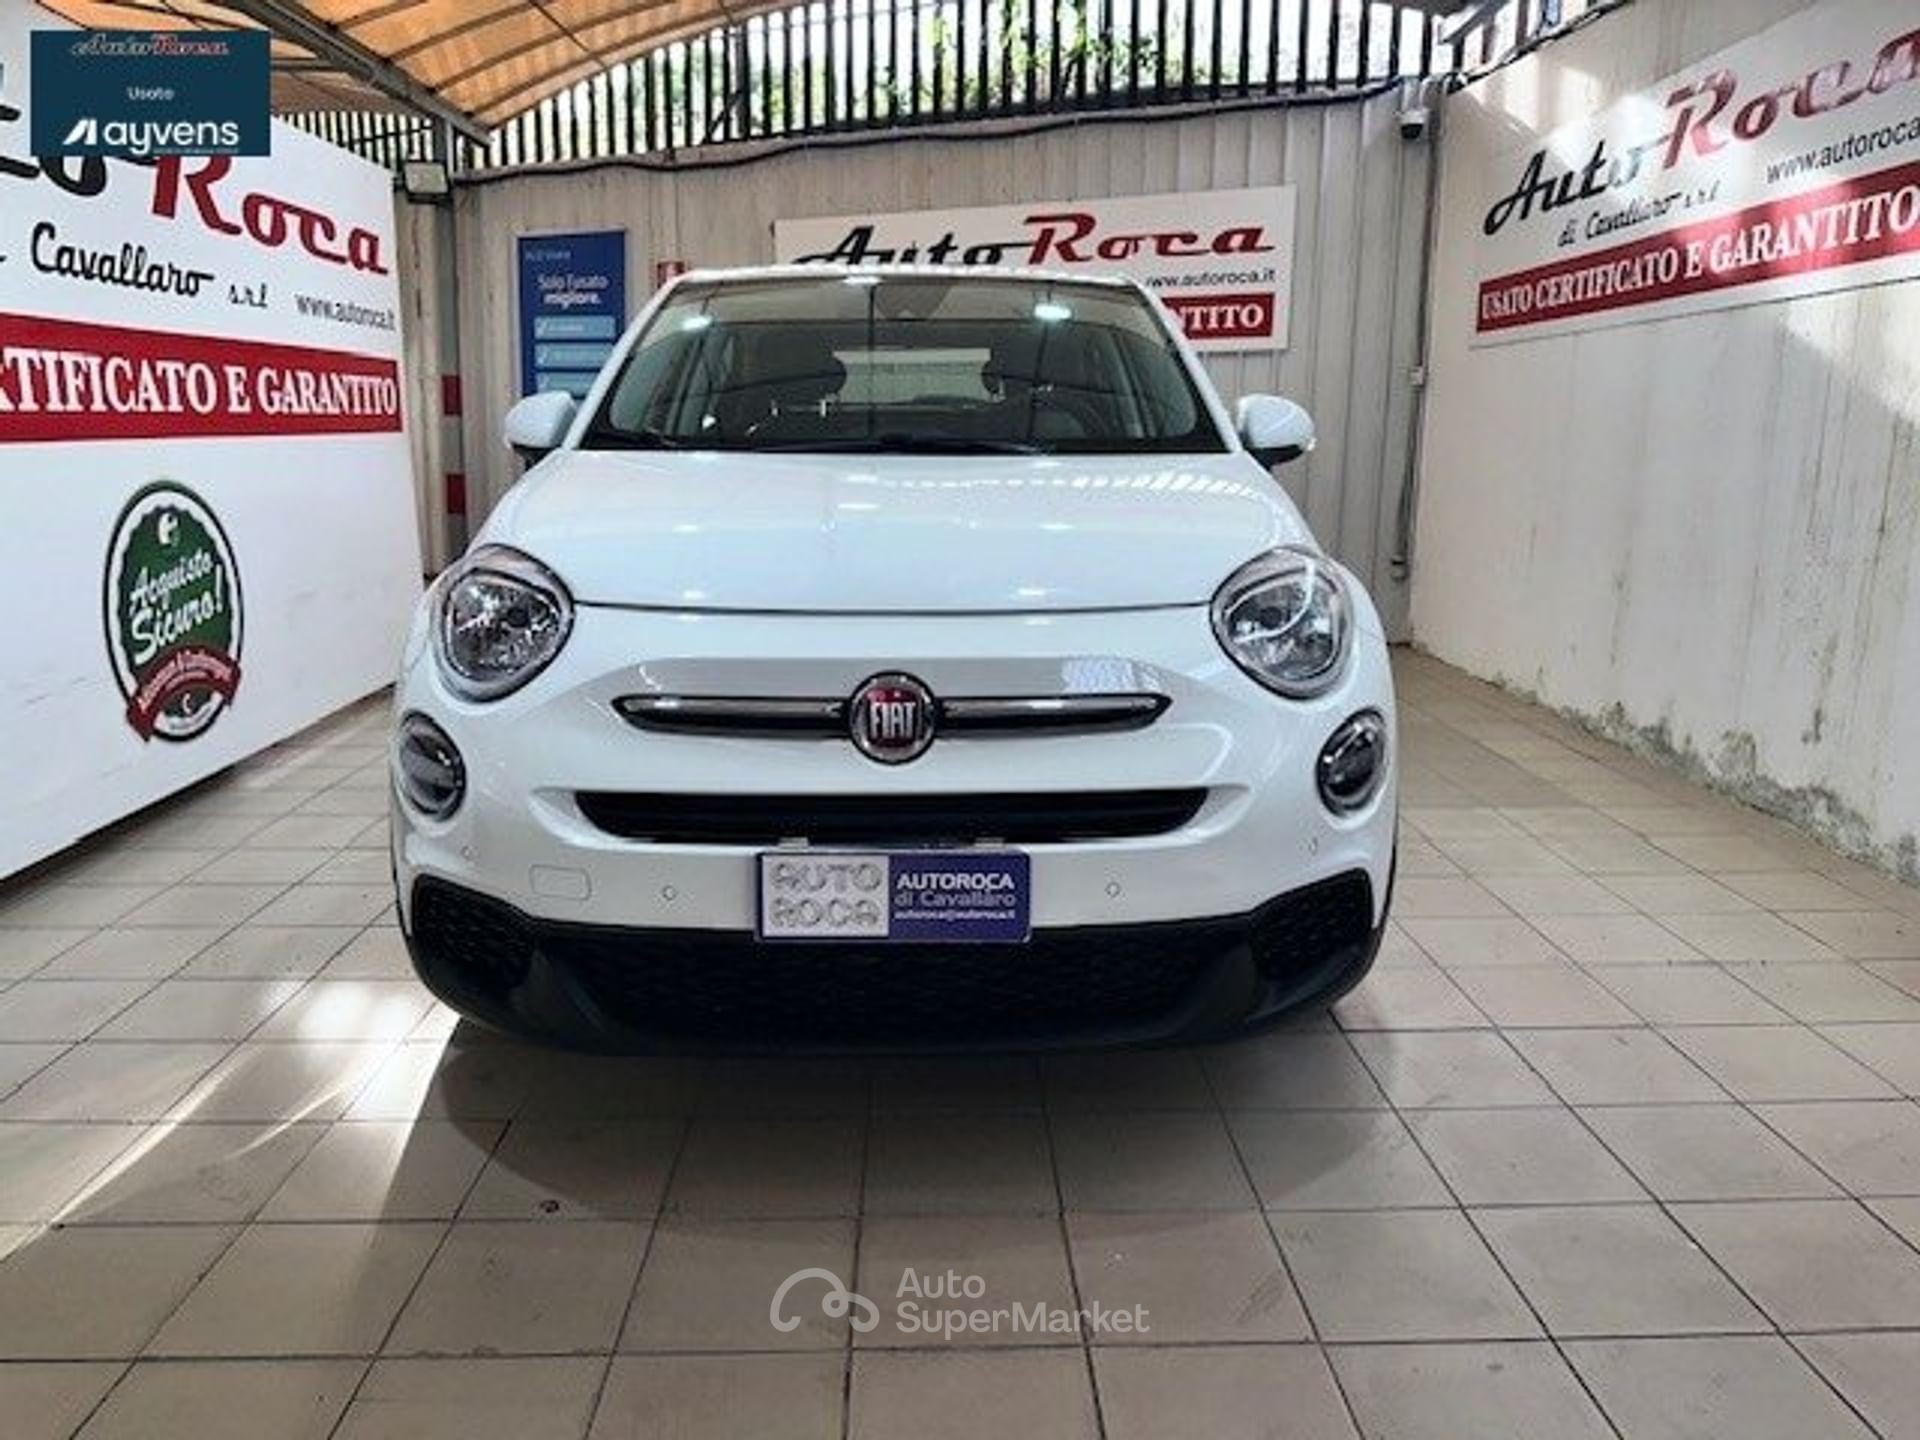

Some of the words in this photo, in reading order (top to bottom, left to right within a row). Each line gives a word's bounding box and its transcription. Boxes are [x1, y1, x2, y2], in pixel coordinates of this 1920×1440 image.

[31, 221, 214, 298] Cavallaro
[1024, 213, 1275, 265] Roca
[1481, 284, 1532, 319] USATO
[1534, 248, 1678, 309] CERTIFICATO
[1685, 240, 1704, 278] E
[1710, 182, 1920, 271] GARANTITO
[223, 365, 252, 412] E
[257, 366, 397, 415] GARANTITO
[132, 563, 223, 665] Sicuro!
[869, 701, 916, 739] FIAT
[769, 862, 882, 892] AUTO
[896, 872, 1015, 889] AUTOROCA
